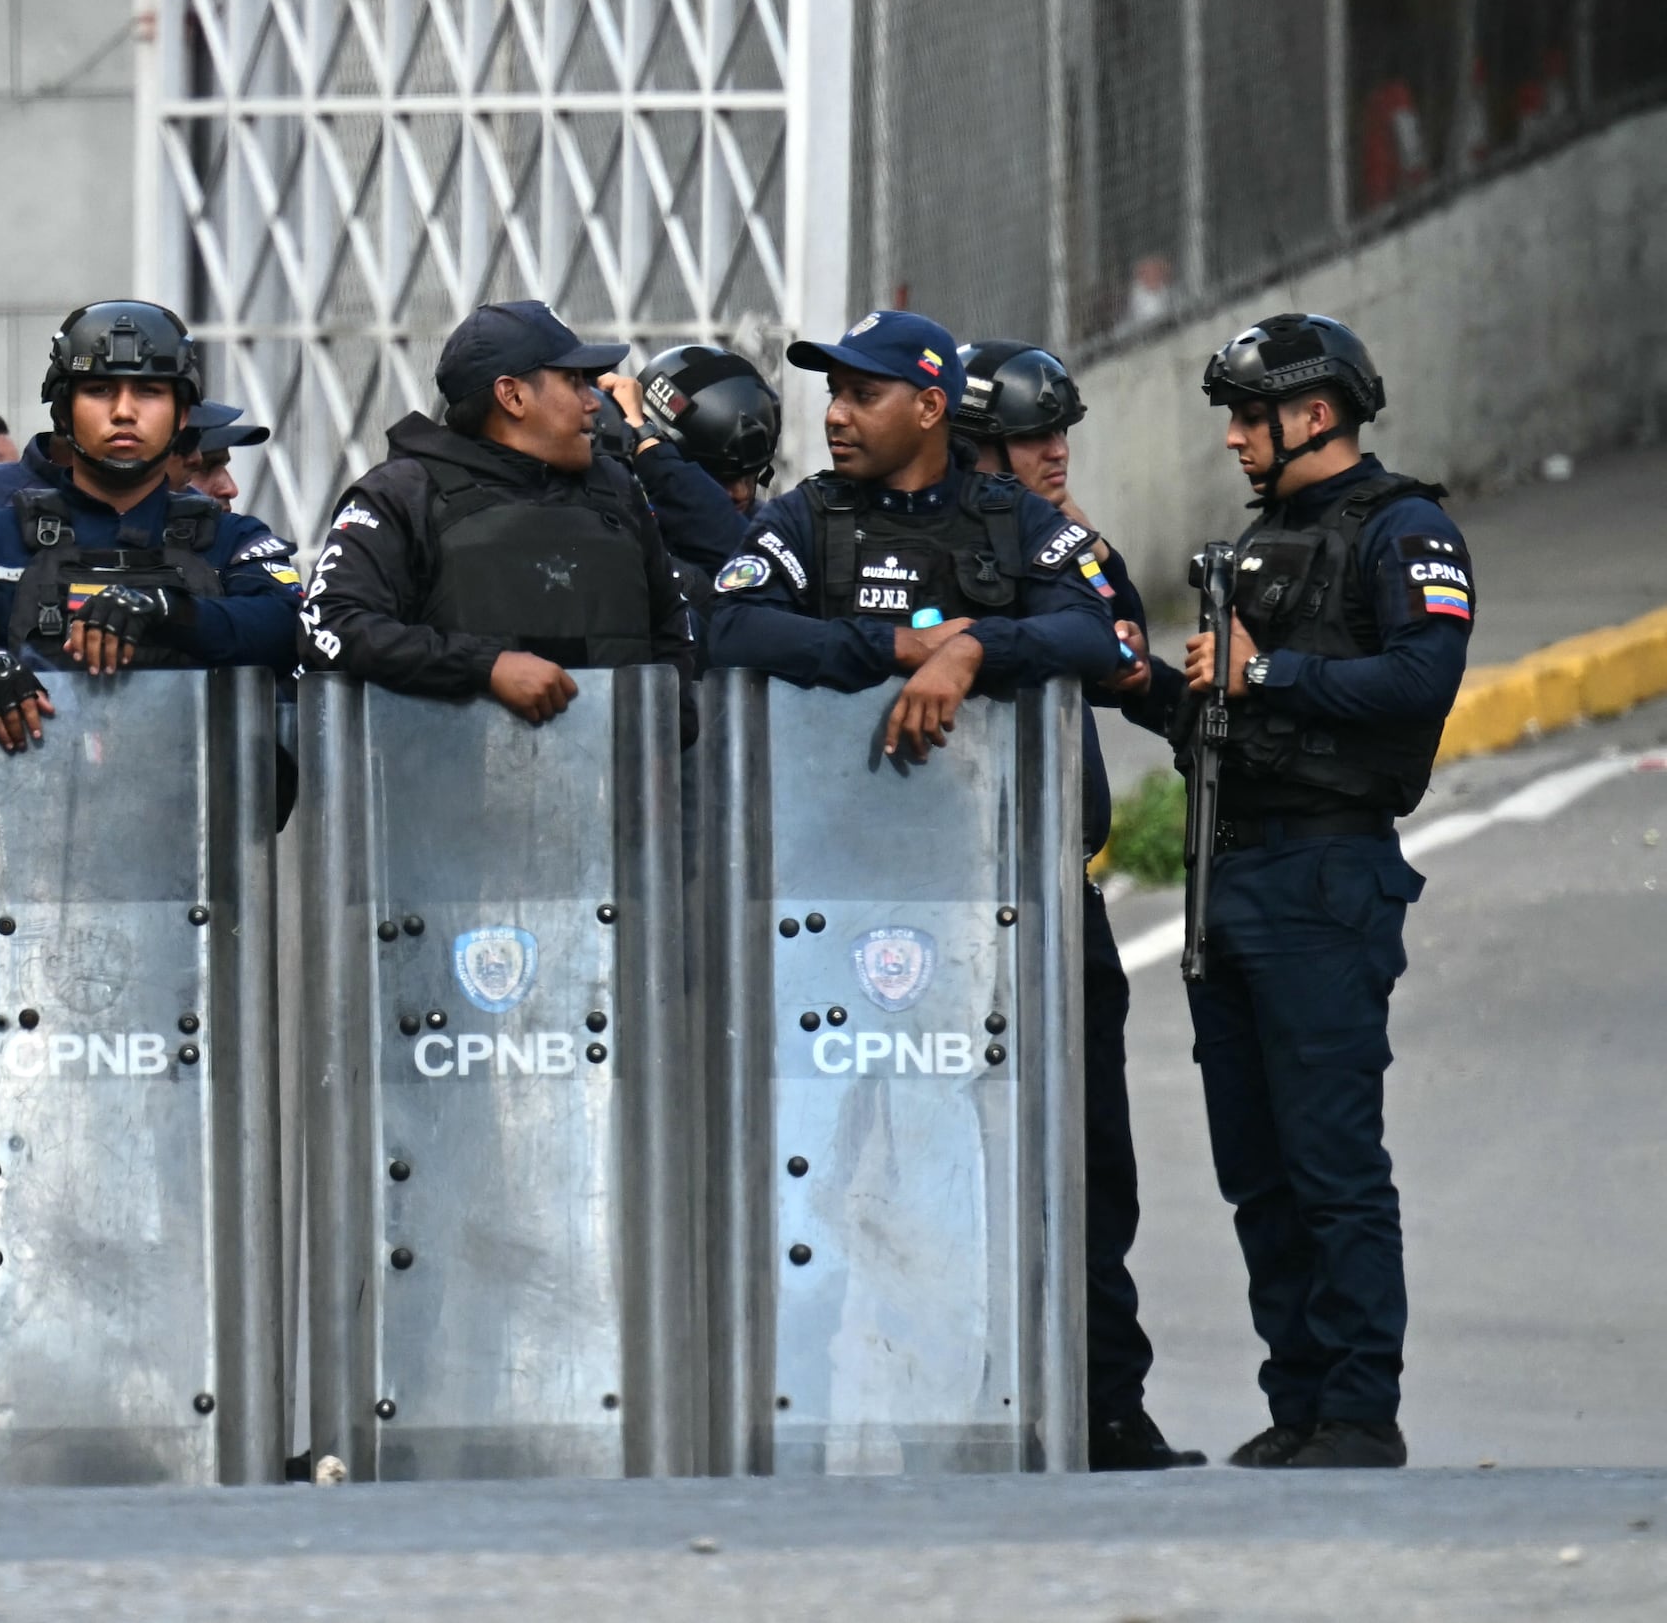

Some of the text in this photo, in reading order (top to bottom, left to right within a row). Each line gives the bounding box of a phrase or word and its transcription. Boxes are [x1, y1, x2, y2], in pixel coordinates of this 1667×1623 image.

[862, 566, 908, 580] GUZMAN
[4, 1032, 168, 1078] CPNB
[414, 1031, 576, 1077] CPNB
[812, 1031, 973, 1074] CPNB
